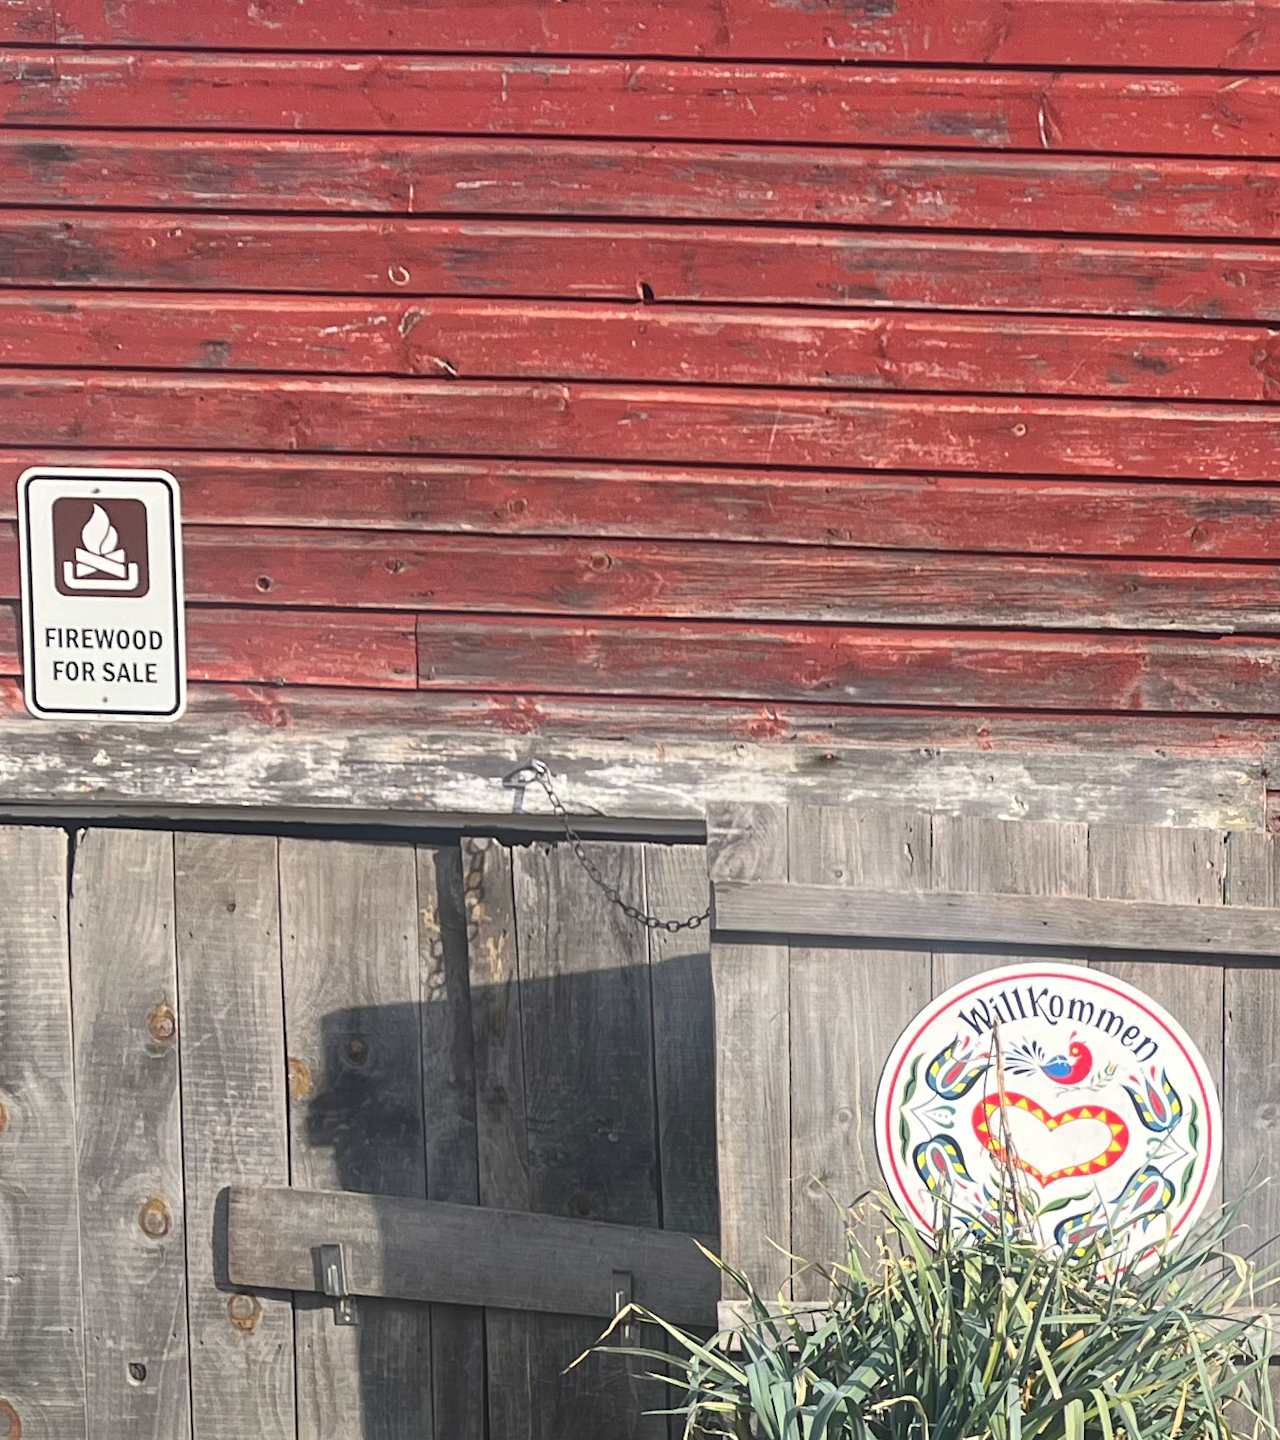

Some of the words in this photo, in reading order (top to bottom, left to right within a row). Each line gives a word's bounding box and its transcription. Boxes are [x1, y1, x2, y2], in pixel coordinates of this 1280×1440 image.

[45, 628, 163, 650] FIREWOOD
[53, 661, 96, 681] FOR
[103, 662, 158, 683] SALE
[958, 985, 1159, 1062] Willkommen
